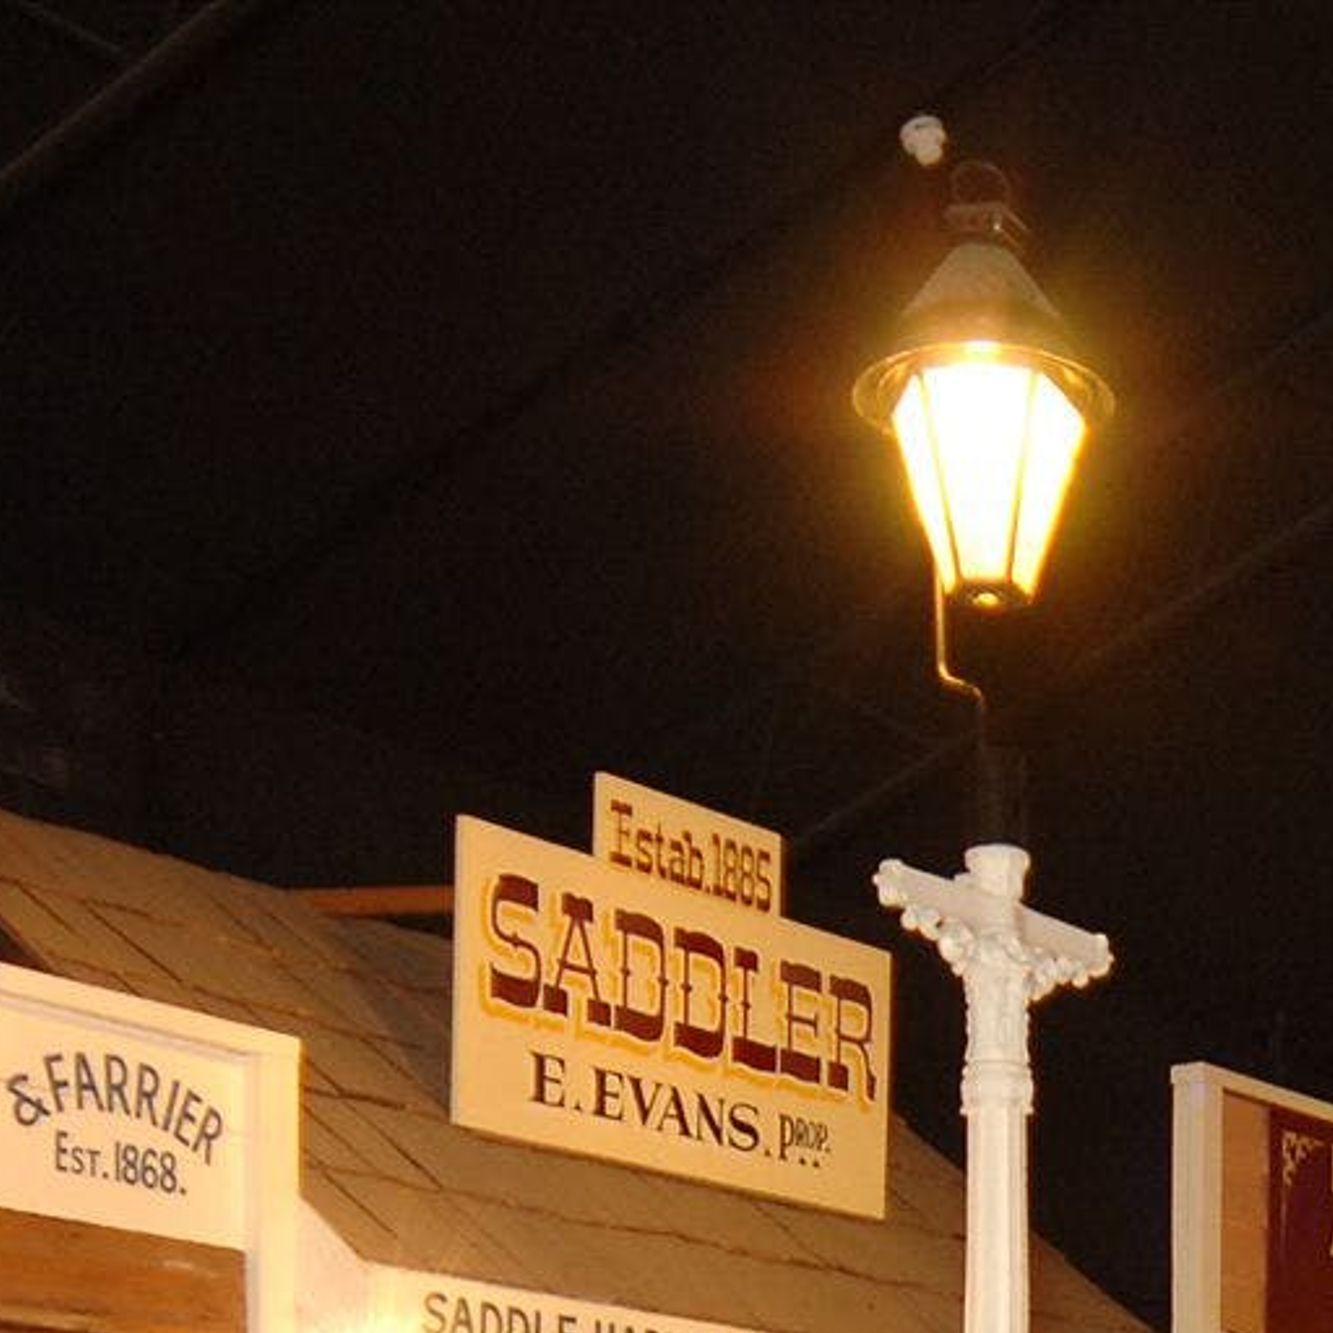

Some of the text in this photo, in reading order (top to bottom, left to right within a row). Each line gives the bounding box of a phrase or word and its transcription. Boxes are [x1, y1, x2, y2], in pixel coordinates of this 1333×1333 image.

[489, 872, 877, 1102] SADDLER
[43, 1051, 223, 1166] FARRIER
[593, 1067, 772, 1158] EVANS.
